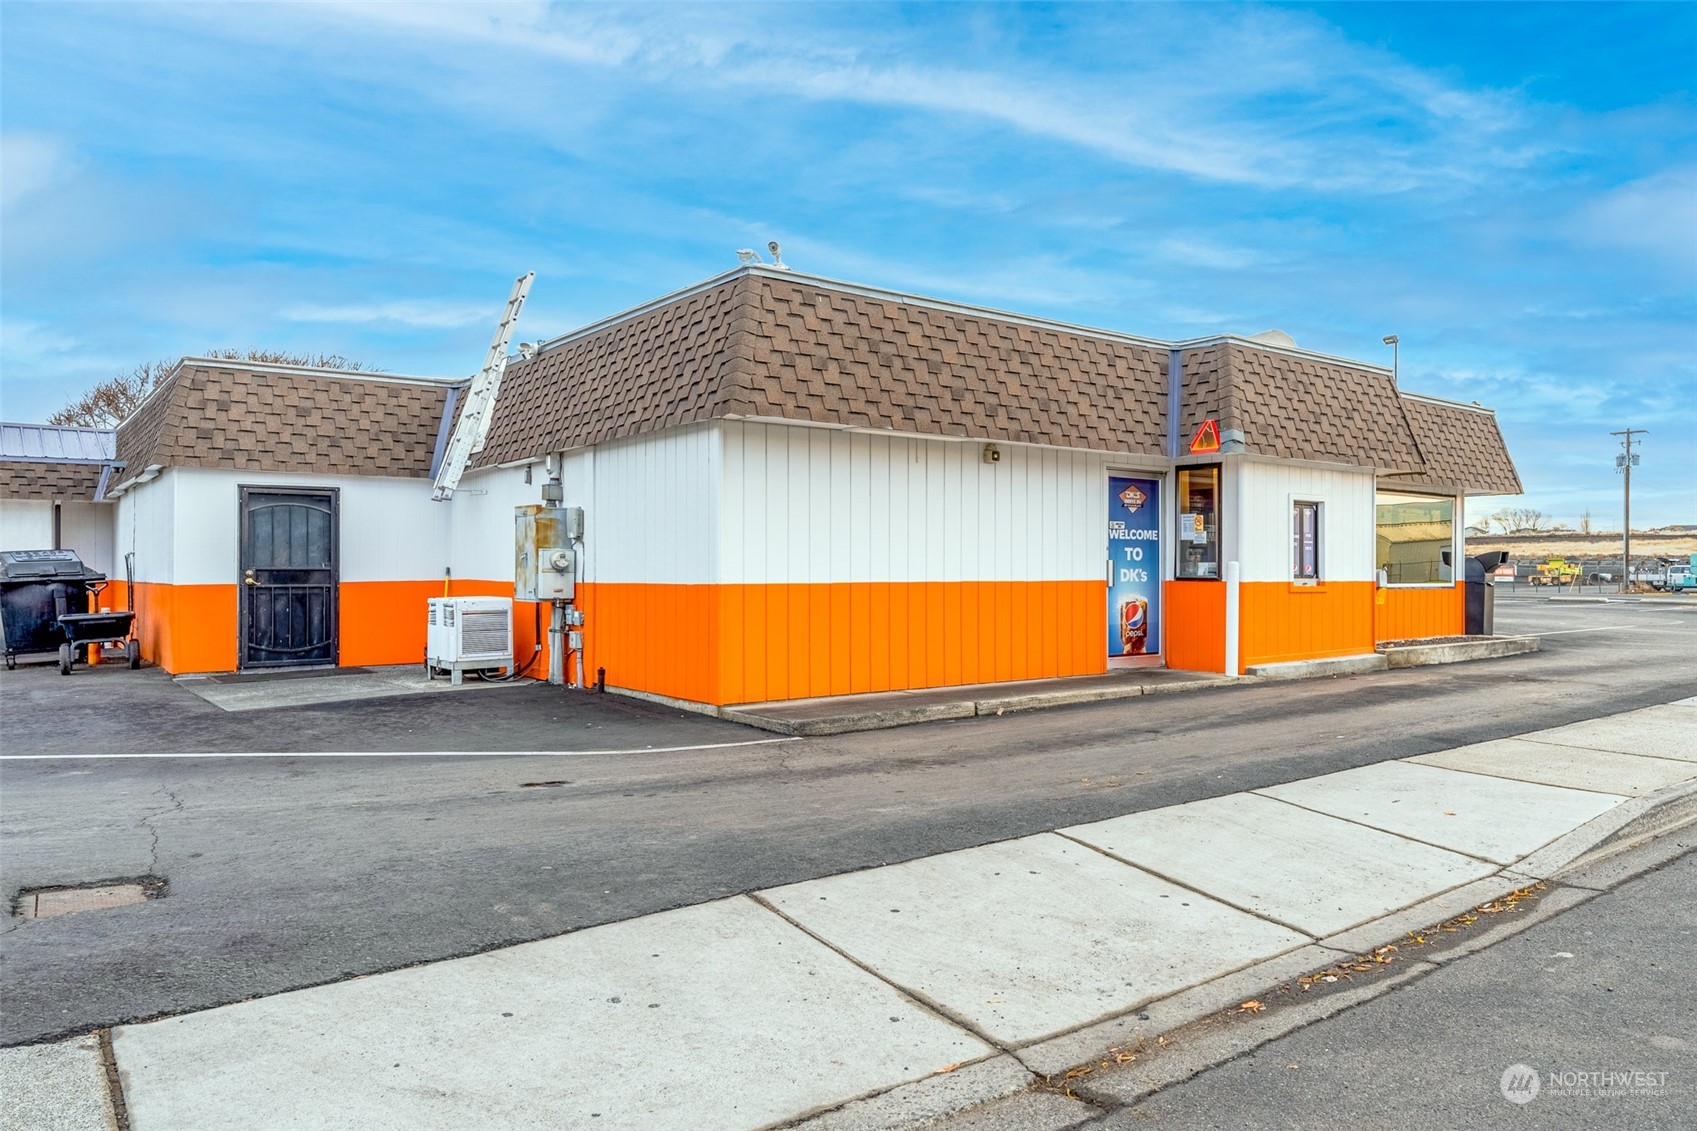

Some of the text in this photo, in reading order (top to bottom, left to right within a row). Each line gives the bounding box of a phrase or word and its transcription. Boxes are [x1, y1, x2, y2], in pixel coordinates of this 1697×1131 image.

[1110, 529, 1158, 540] WELCOME
[1124, 548, 1143, 561] TO
[1120, 569, 1147, 582] DK's
